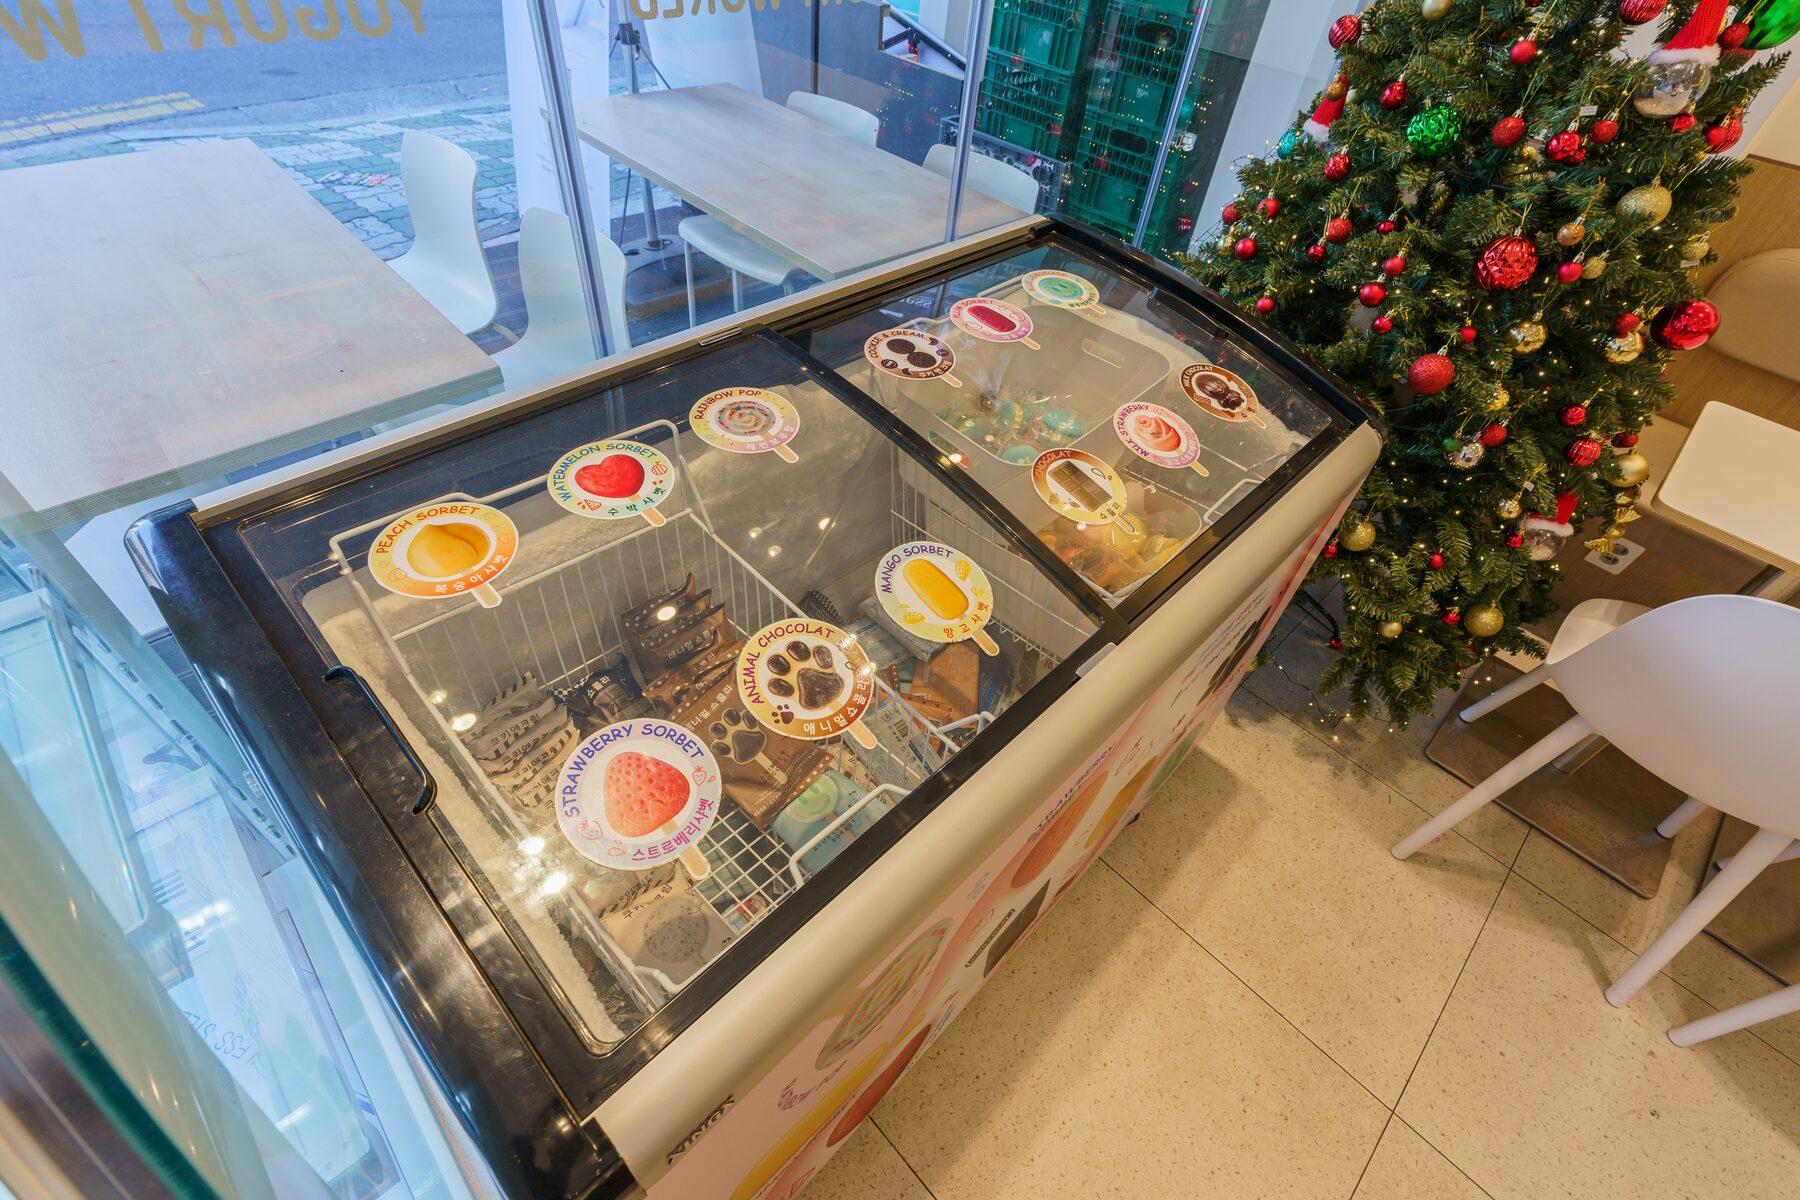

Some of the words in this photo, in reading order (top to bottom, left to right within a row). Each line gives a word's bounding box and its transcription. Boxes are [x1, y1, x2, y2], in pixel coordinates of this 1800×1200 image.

[868, 336, 883, 359] COOKIE
[891, 330, 925, 339] CREAM
[694, 389, 733, 420] RAINBOW
[738, 389, 762, 397] POP
[1117, 404, 1149, 437] STRAWBERRY
[1125, 438, 1150, 457] MILK
[553, 445, 601, 502] WATERMELON
[605, 443, 657, 459] SORBET
[375, 520, 413, 554] PEACH
[416, 505, 481, 522] SORBET
[881, 554, 902, 594] MANGO
[903, 545, 954, 559] SORBET
[742, 651, 765, 705] ANIMAL
[757, 623, 835, 649] CHOCOLAT
[562, 724, 633, 819] STRAWBERRY
[641, 724, 705, 760] SORBET
